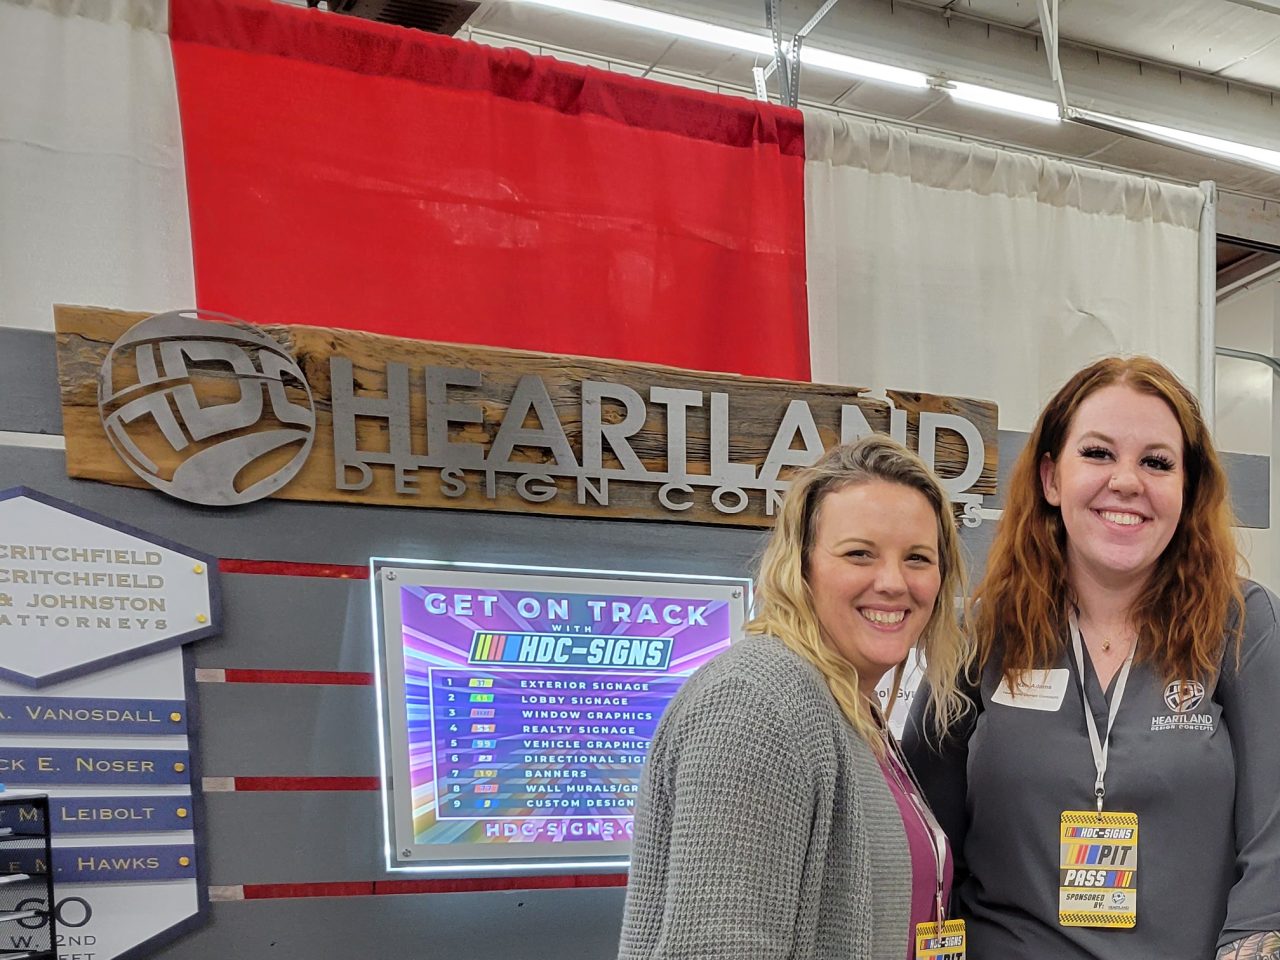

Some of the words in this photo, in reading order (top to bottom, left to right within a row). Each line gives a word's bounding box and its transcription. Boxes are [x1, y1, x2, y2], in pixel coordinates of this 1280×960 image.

[335, 460, 610, 507] DESIGN
[0, 544, 163, 566] CRITCHFIELD
[0, 568, 165, 589] CRITCHFIELD
[26, 593, 166, 612] JOHNSTON
[424, 592, 499, 617] GET
[517, 597, 569, 621] ON
[587, 600, 709, 627] TRACK
[0, 614, 168, 630] ATTORNEYS
[551, 623, 593, 634] WITH
[517, 635, 665, 666] HDC-SIGNS
[447, 678, 452, 686] 1
[520, 680, 587, 690] EXTERIOR
[592, 681, 650, 691] SIGNAGE
[448, 693, 456, 702] 2
[521, 695, 566, 704] LOBBY
[571, 696, 629, 706] SIGNAGE
[25, 705, 161, 723] VANOSDALL
[448, 709, 456, 717] 3
[522, 710, 581, 720] WINDOW
[587, 711, 653, 721] GRAPHICS
[1151, 713, 1214, 725] HEARTLAND
[450, 724, 458, 732] 4
[522, 725, 573, 734] REALTY
[578, 726, 636, 735] SIGNAGE
[450, 739, 458, 747] 5
[523, 740, 581, 748] VEHICLE
[587, 740, 651, 749] GRAPHICS
[38, 757, 61, 772] E.
[76, 757, 155, 773] NOSER
[451, 754, 459, 763] 6
[524, 754, 615, 763] DIRECTIONAL
[452, 769, 459, 778] 7
[524, 769, 588, 778] BANNERS
[453, 784, 460, 793] 8
[526, 784, 561, 793] WALL
[453, 799, 461, 808] 9
[526, 799, 580, 808] CUSTOM
[61, 806, 156, 822] LEIBOLT
[1080, 827, 1133, 840] HDC-SIGNS
[1097, 844, 1133, 866] PIT
[76, 856, 161, 872] HAWKS
[1063, 869, 1107, 887] PASS
[1065, 893, 1105, 902] SPONSORED
[55, 934, 97, 947] 2ND
